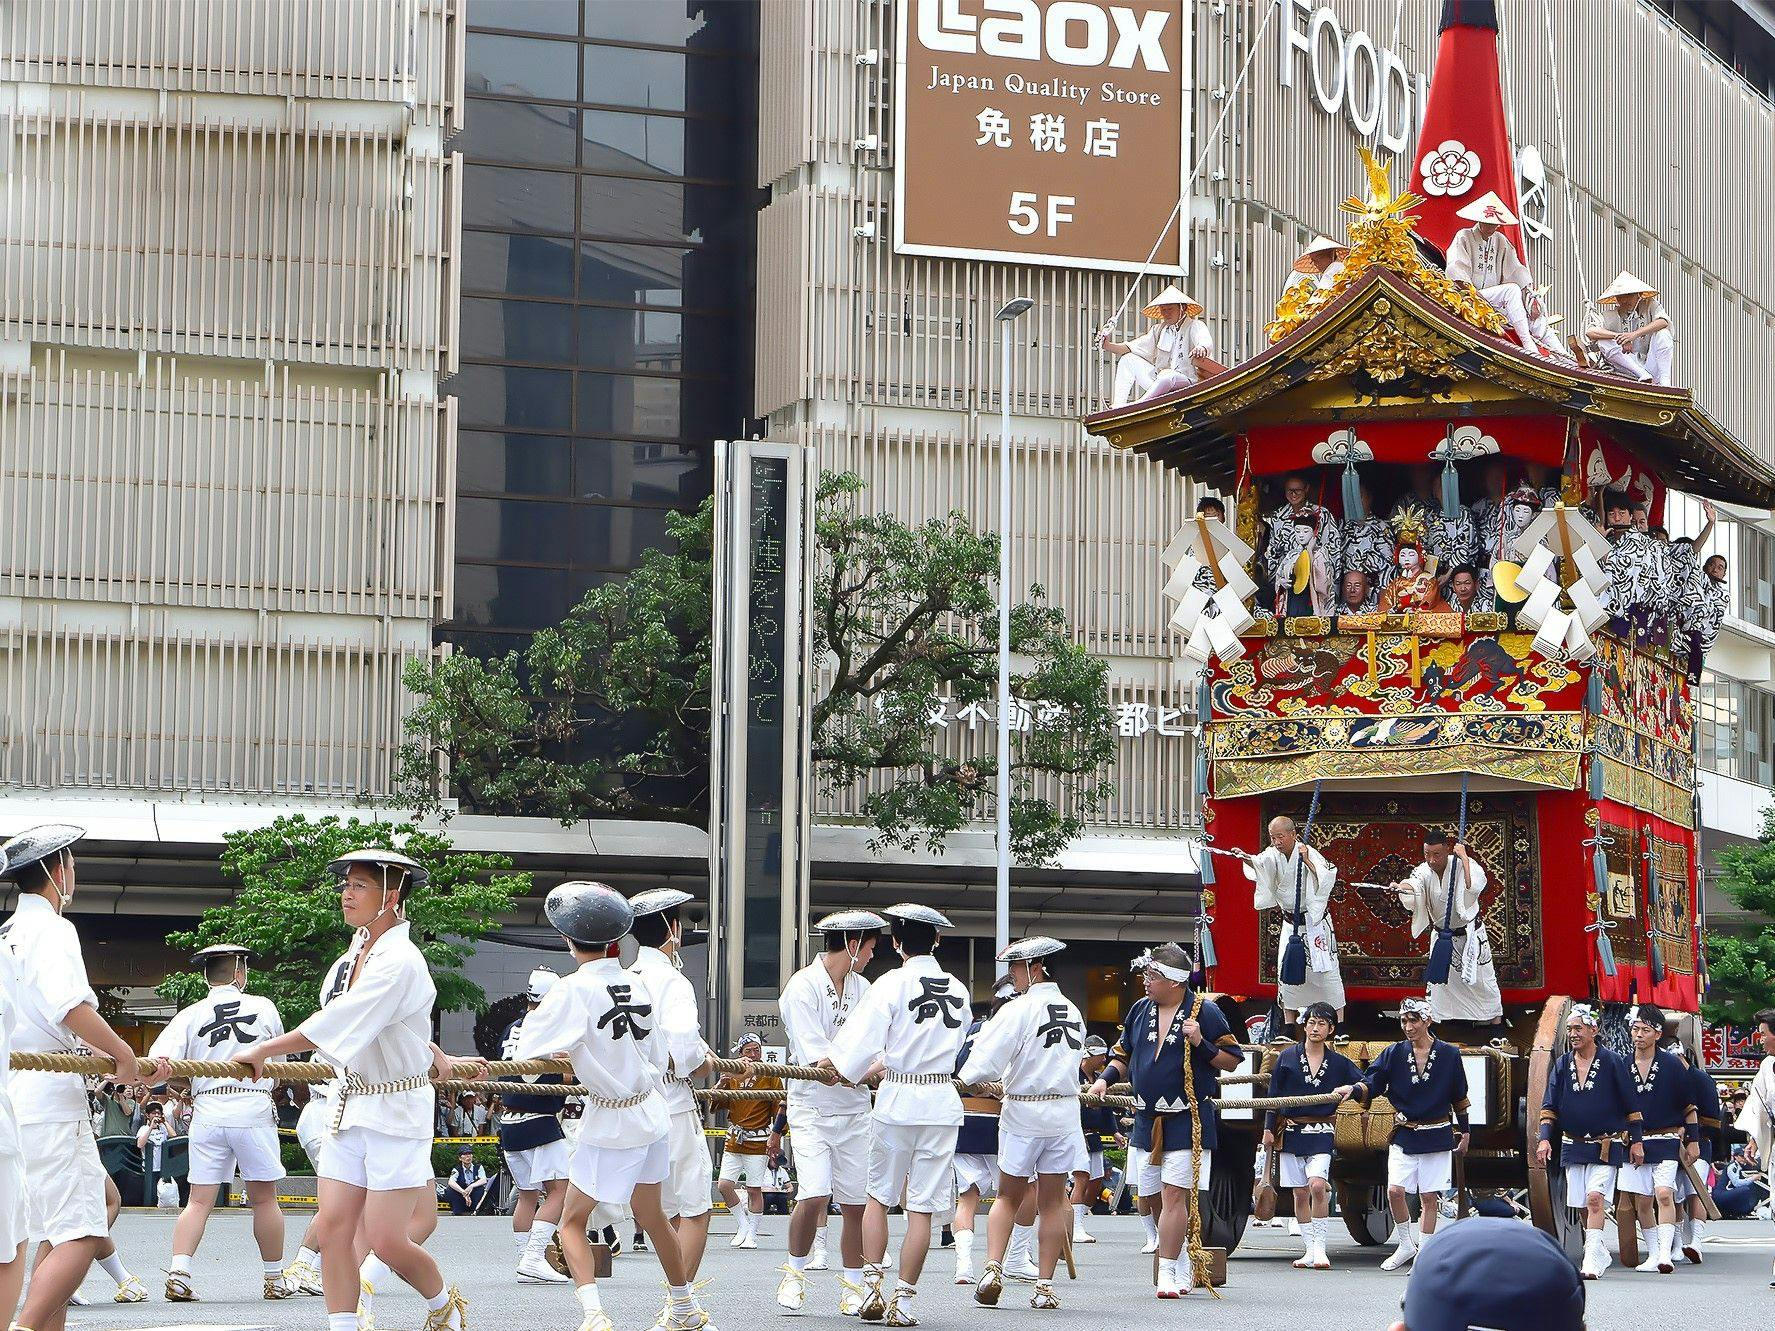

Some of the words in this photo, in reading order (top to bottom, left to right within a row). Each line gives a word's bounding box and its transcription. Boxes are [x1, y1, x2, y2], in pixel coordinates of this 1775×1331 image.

[927, 65, 995, 94] Japan
[1004, 73, 1090, 105] Quality
[1101, 82, 1161, 106] Store
[975, 106, 1121, 158] 免税店
[1007, 191, 1076, 237] 5F
[198, 1000, 258, 1048] 長
[597, 984, 652, 1041] 長
[744, 1014, 779, 1027] 京都市
[908, 976, 964, 1029] 長
[1036, 1003, 1082, 1050] 長
